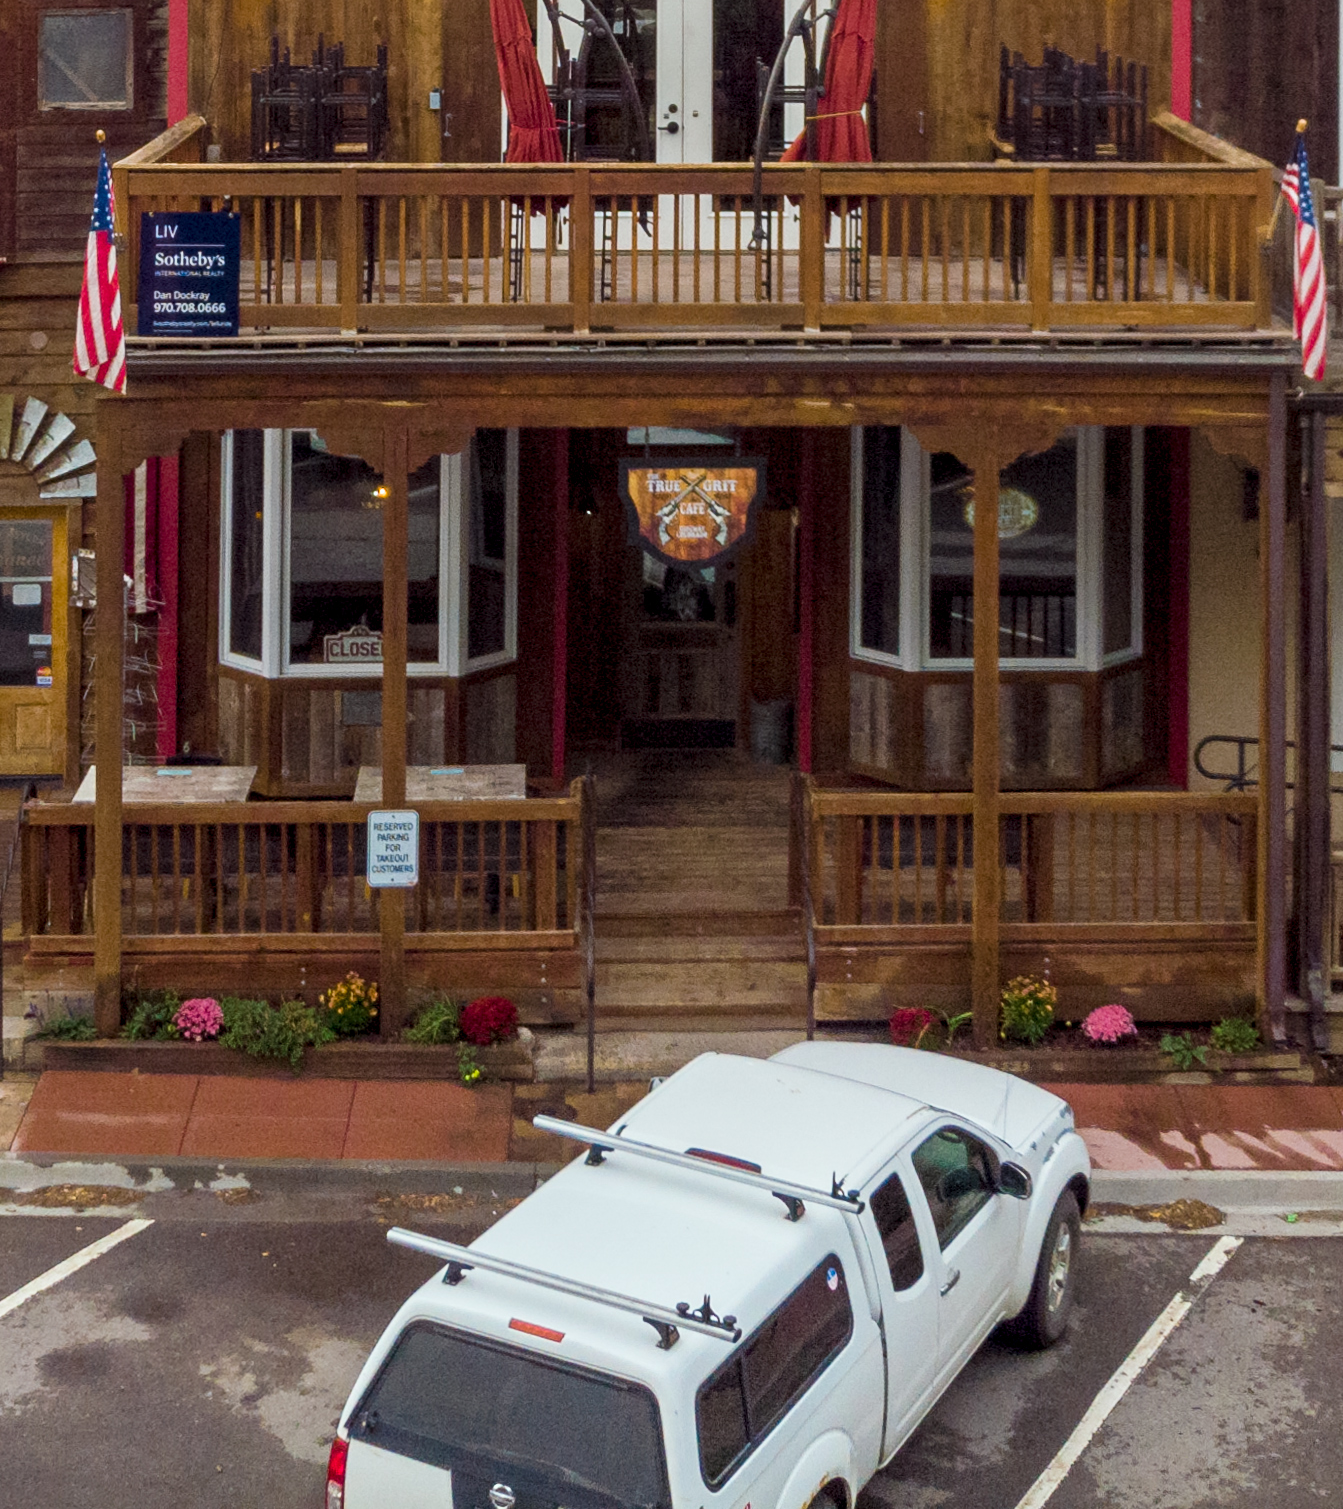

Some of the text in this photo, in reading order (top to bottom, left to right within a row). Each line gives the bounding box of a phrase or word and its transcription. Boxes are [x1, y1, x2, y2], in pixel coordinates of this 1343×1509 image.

[155, 225, 178, 238] LIV
[154, 251, 225, 269] Sotheby's
[154, 291, 210, 301] Dan Dockray
[154, 302, 226, 313] 970.708.0666
[646, 480, 738, 492] TRUE GRIT
[680, 502, 705, 515] CAFE
[329, 641, 383, 657] CLOSE
[373, 823, 413, 831] RESERVED
[377, 833, 409, 842] PARKING
[385, 844, 401, 852] FOR
[376, 854, 409, 863] TAKEOUT
[372, 865, 414, 873] CUSTOMERS
